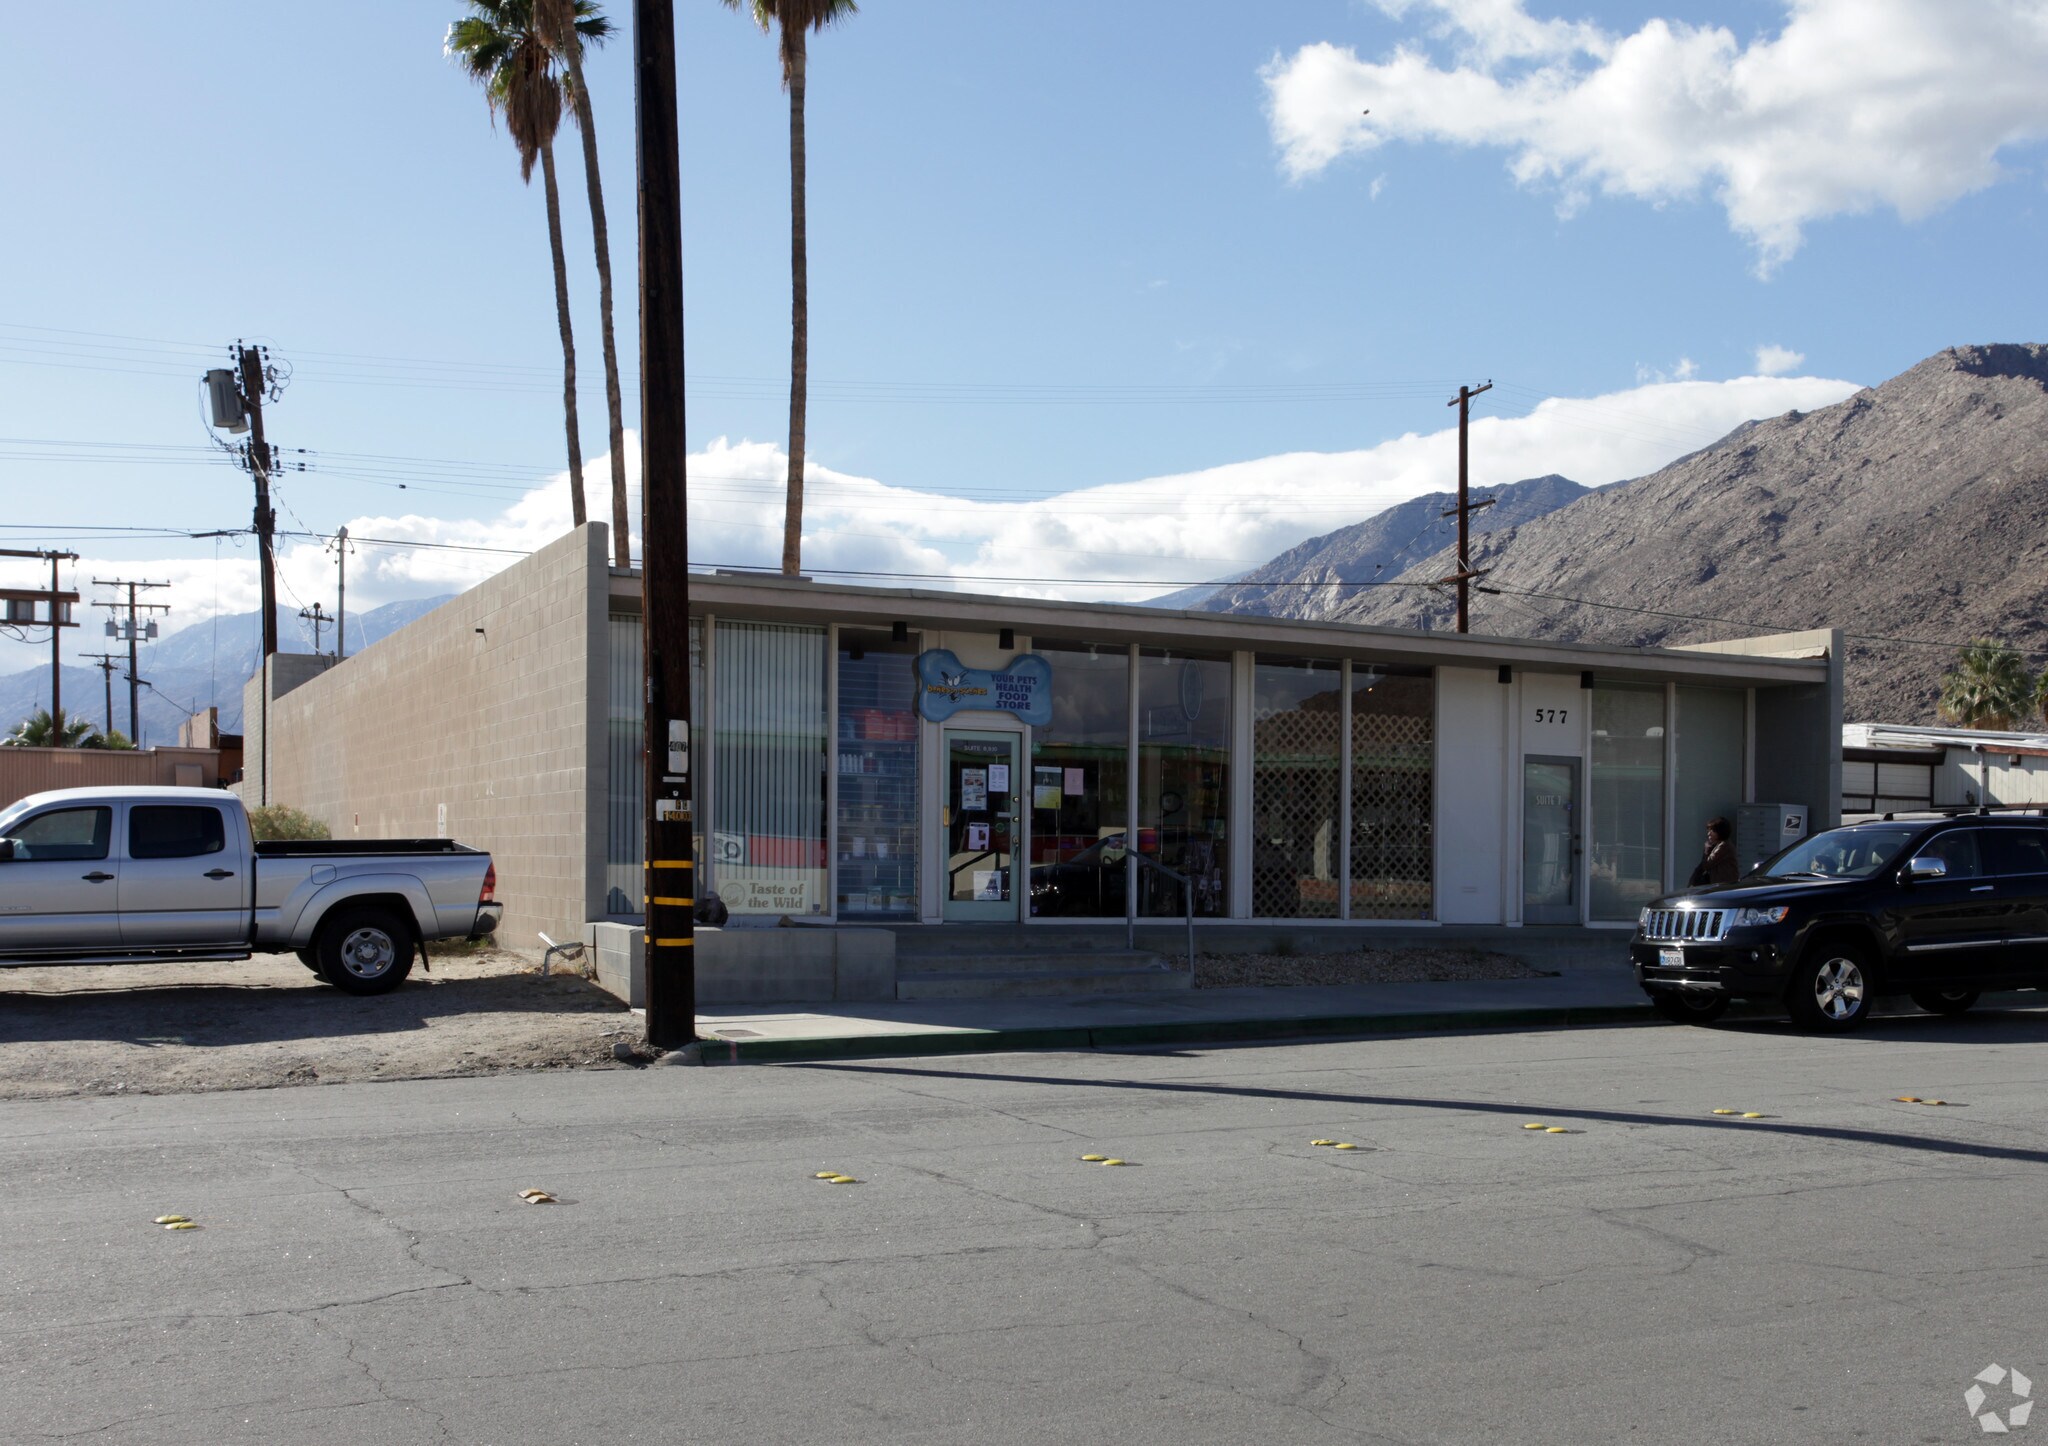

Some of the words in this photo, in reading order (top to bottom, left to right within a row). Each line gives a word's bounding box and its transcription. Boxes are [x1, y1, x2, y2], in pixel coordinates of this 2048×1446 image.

[991, 673, 1014, 683] YOUR
[1017, 675, 1037, 685] PETS
[995, 683, 1032, 693] HEALTH
[999, 692, 1028, 701] FOOD
[995, 700, 1031, 710] STORE
[1534, 708, 1568, 724] 577
[963, 744, 980, 752] SUITE
[1536, 795, 1554, 806] SUITE
[749, 883, 785, 894] Taste
[790, 883, 804, 895] of
[748, 897, 769, 908] the
[774, 897, 803, 908] Wild
